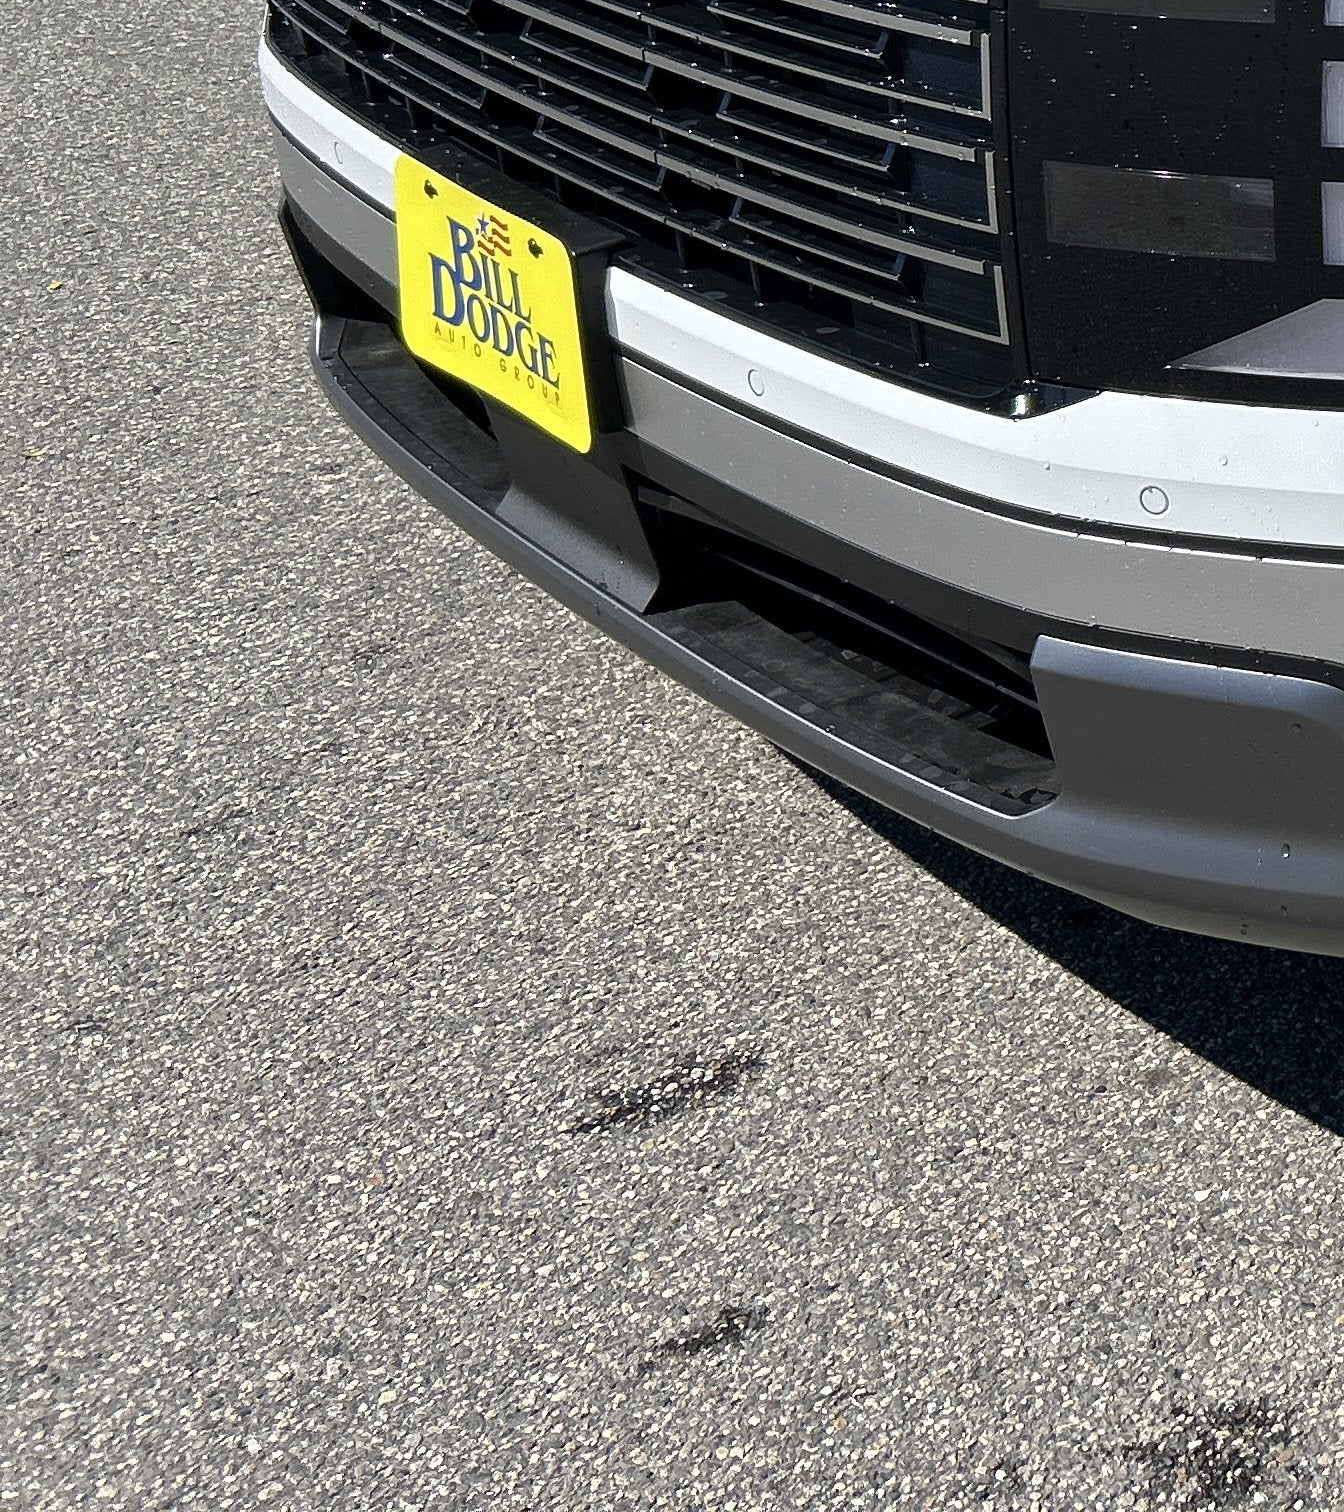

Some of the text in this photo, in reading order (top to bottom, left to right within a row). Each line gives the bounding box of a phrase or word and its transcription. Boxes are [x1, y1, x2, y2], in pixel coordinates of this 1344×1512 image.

[428, 252, 560, 390] DODGE
[446, 215, 532, 324] BILL
[434, 321, 561, 407] AUTO GROUP
